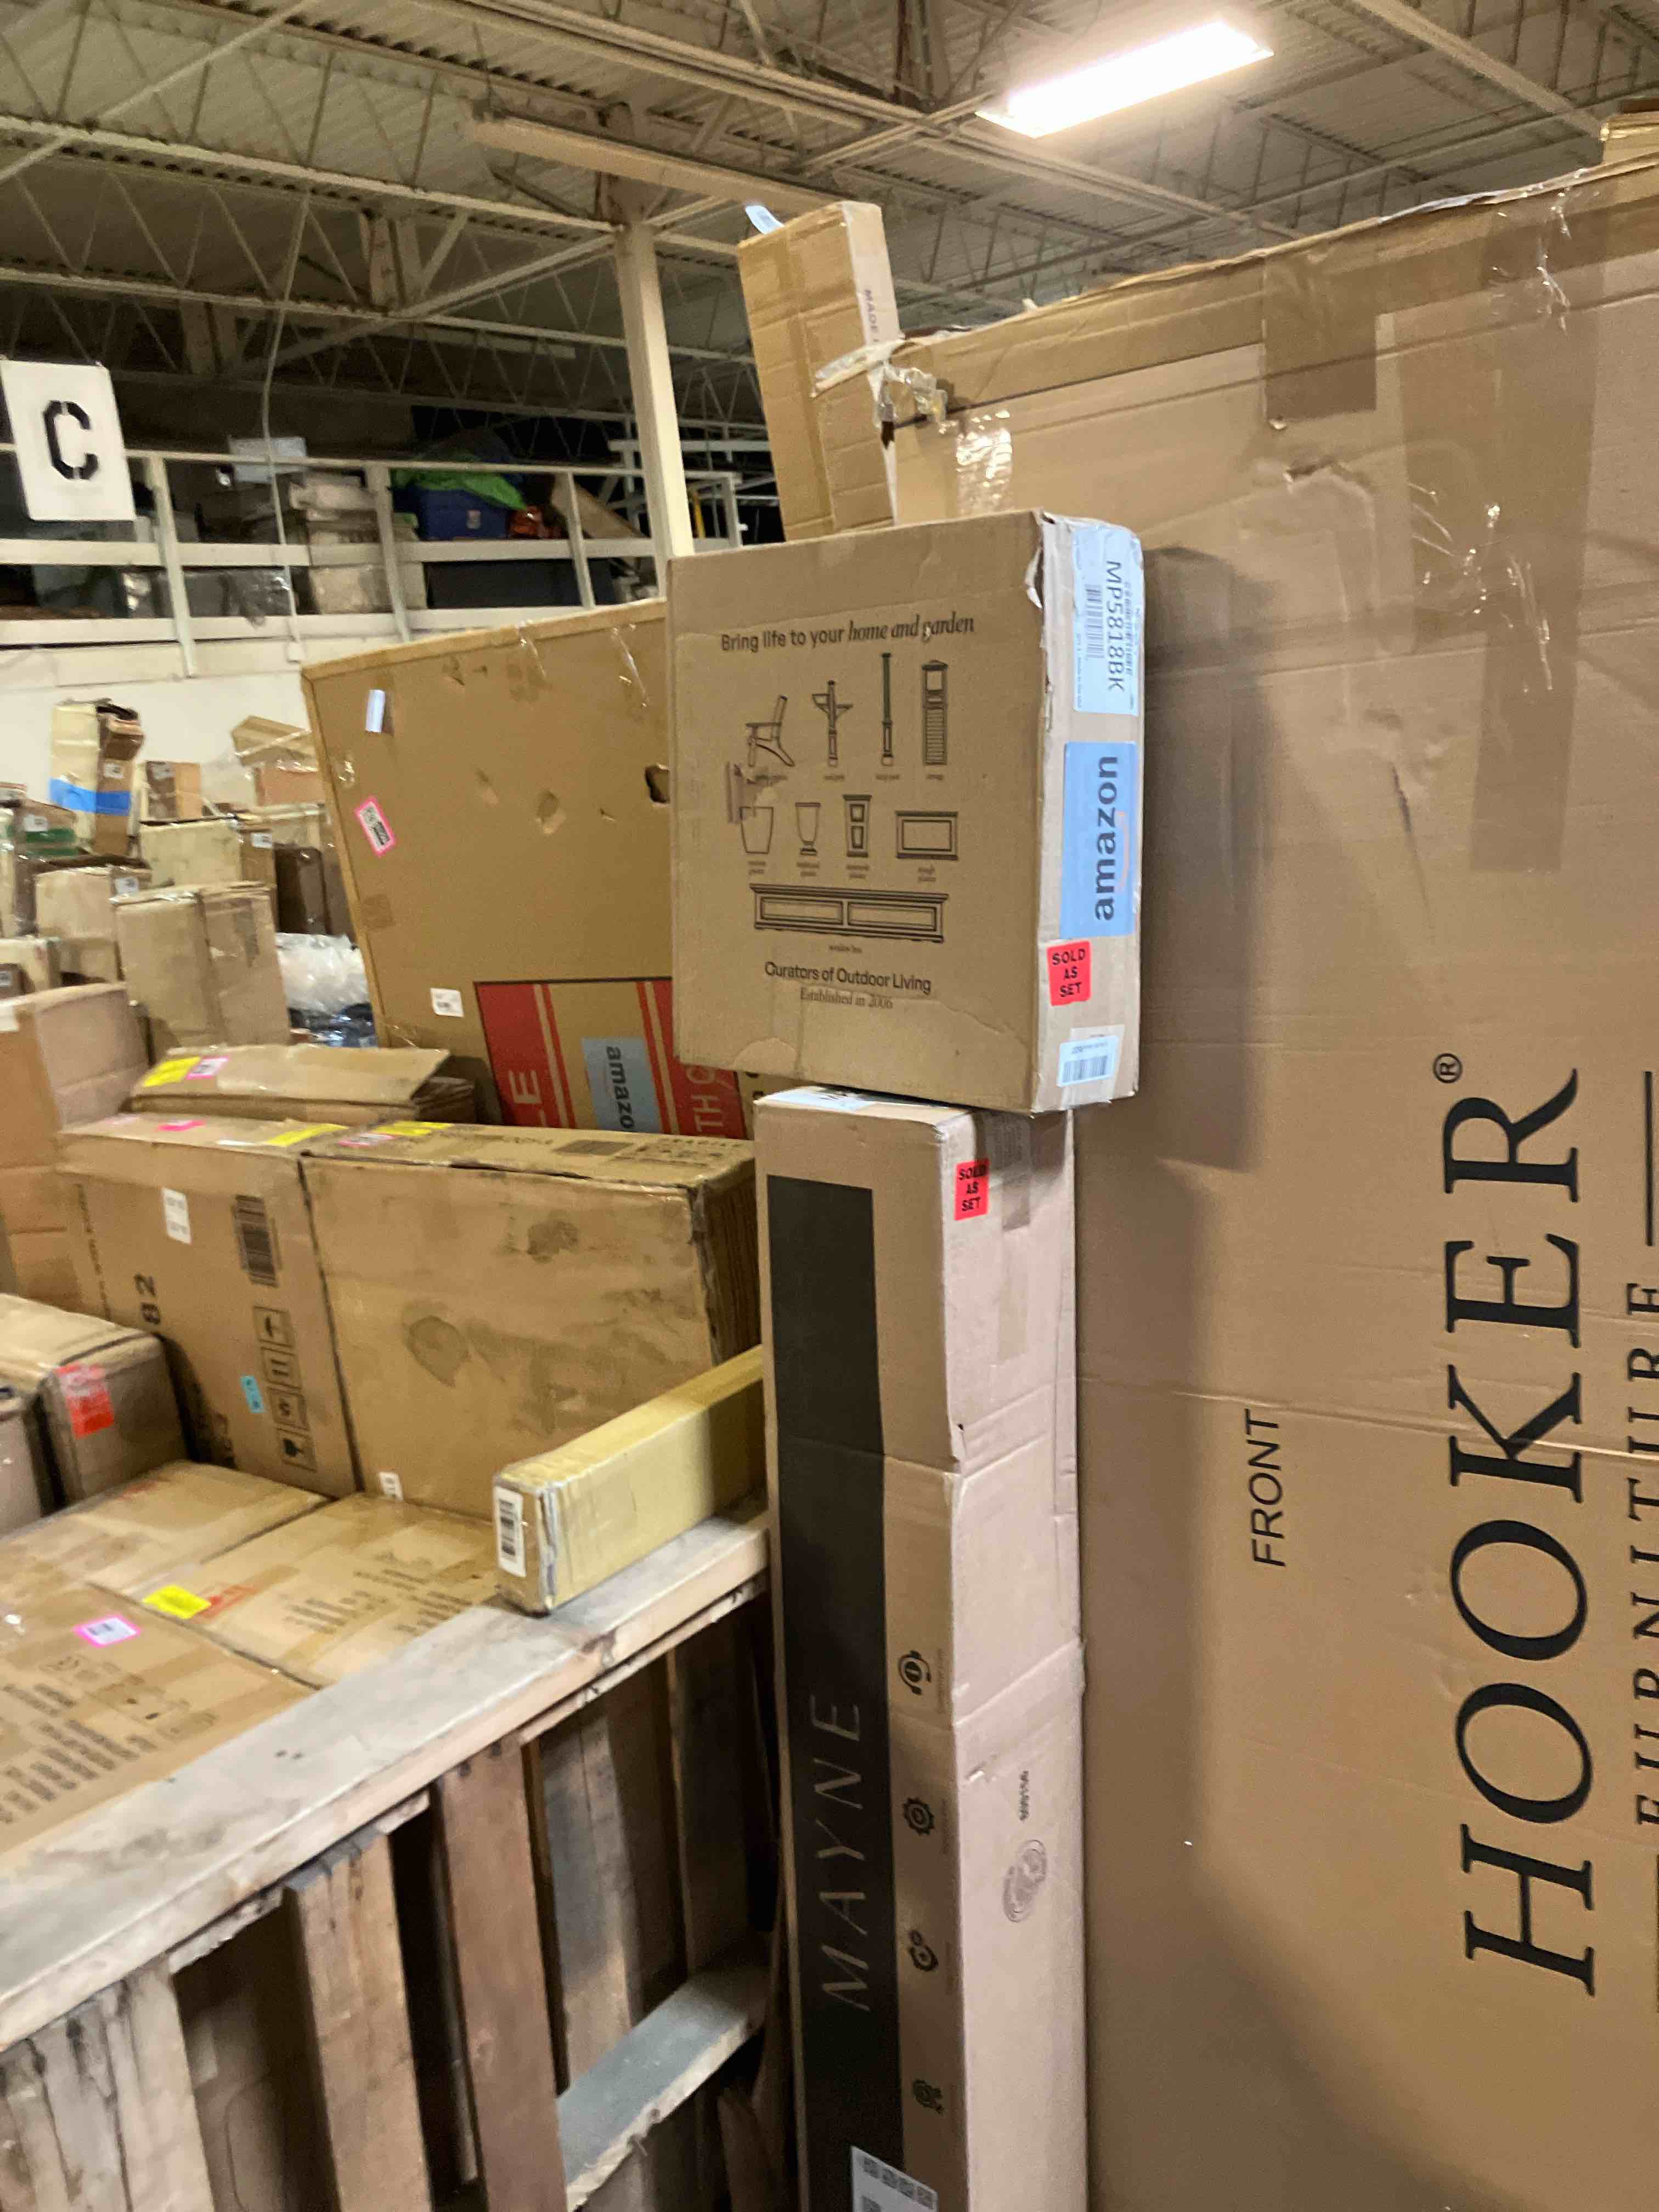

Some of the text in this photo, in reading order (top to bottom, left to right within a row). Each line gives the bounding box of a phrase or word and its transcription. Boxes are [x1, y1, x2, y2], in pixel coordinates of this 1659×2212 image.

[864, 289, 879, 334] MADE
[42, 399, 99, 480] C
[721, 611, 975, 652] Bring life to your home and garden
[1106, 560, 1125, 692] MP5818BK
[1094, 757, 1119, 921] amazon
[764, 961, 931, 995] Curators of Outdoor Living
[1052, 949, 1086, 966] SOLD
[1063, 966, 1078, 980] AS
[800, 988, 852, 1005] Established
[855, 996, 865, 1007] in
[1059, 982, 1082, 998] SET
[1244, 1408, 1286, 1567] FRONT
[1442, 1068, 1595, 1997] HOOKER
[809, 1694, 873, 2012] MAYNE
